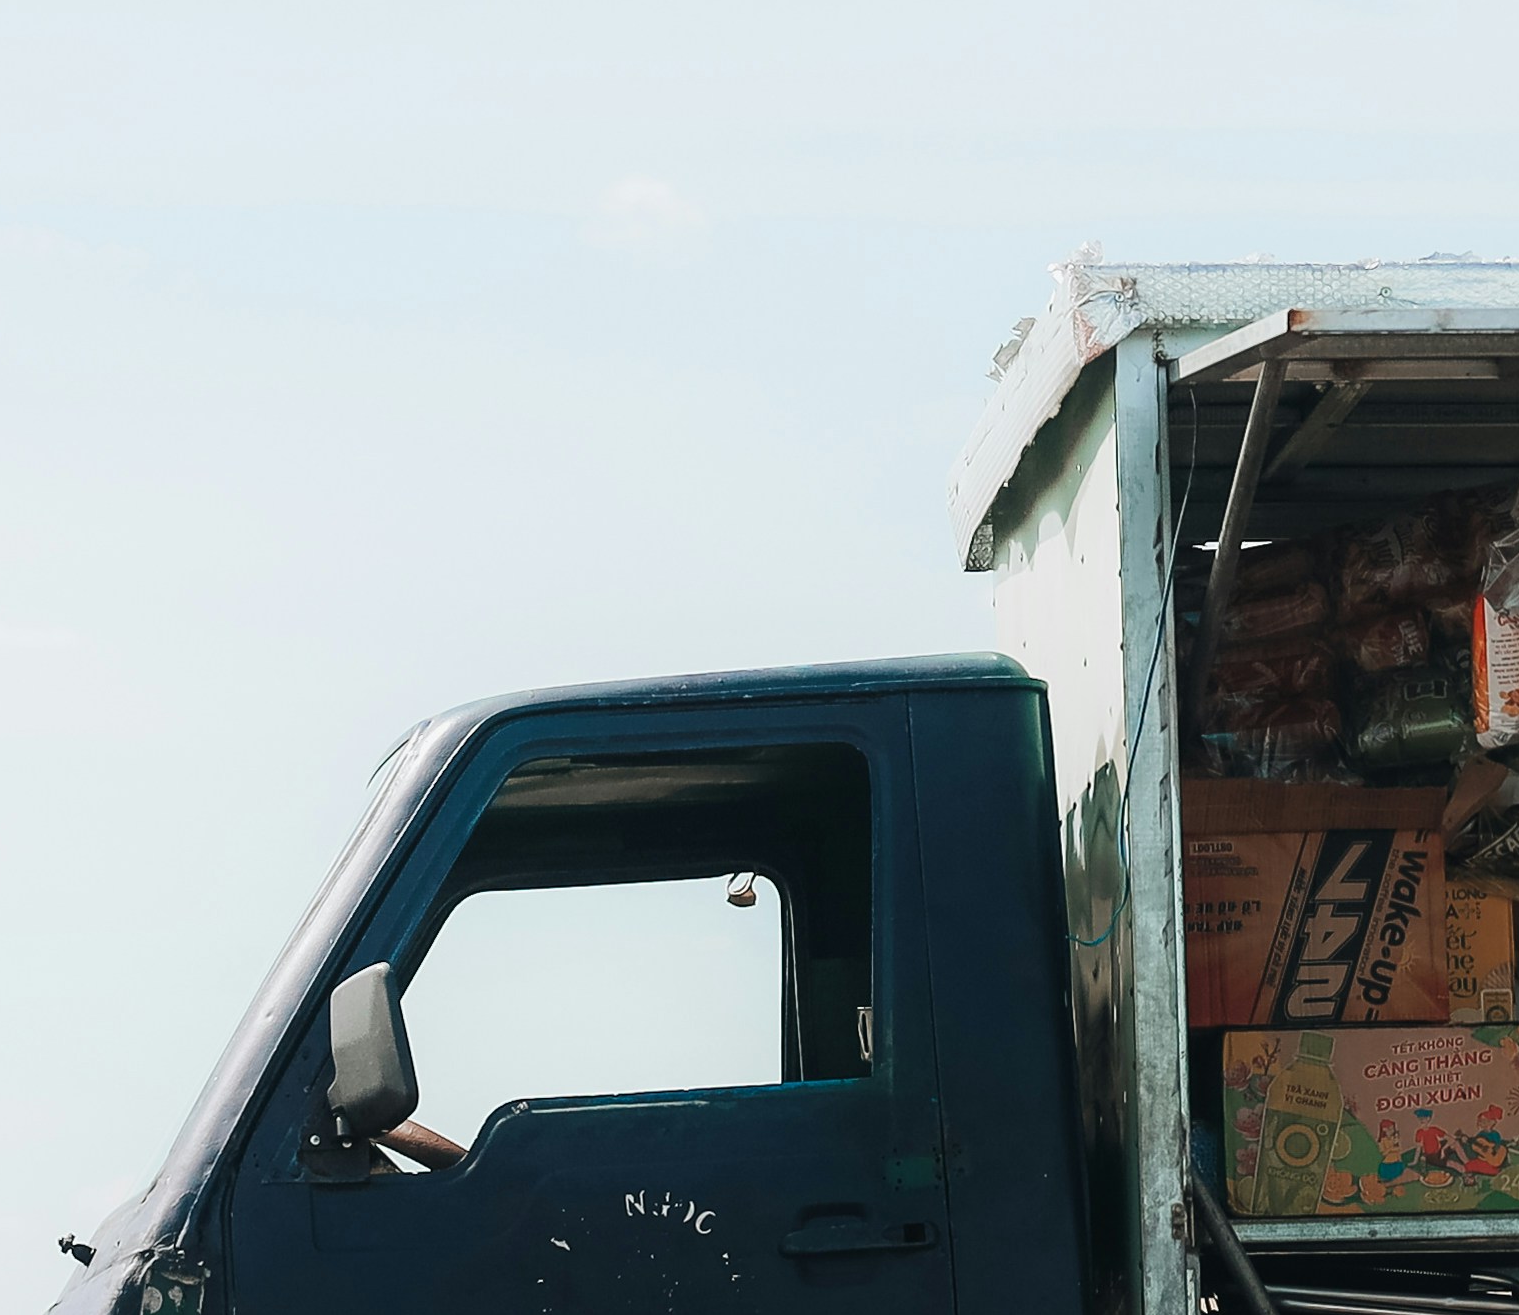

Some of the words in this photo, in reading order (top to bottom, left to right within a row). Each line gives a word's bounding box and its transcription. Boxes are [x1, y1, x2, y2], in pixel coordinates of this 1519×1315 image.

[1392, 1040, 1417, 1055] TẾT
[1418, 1035, 1464, 1052] KHÔNG
[1364, 1056, 1420, 1080] CĂNG
[1424, 1071, 1462, 1087] NHIỆT
[1376, 1091, 1422, 1113] ĐÓN
[1425, 1084, 1481, 1104] XUÂN
